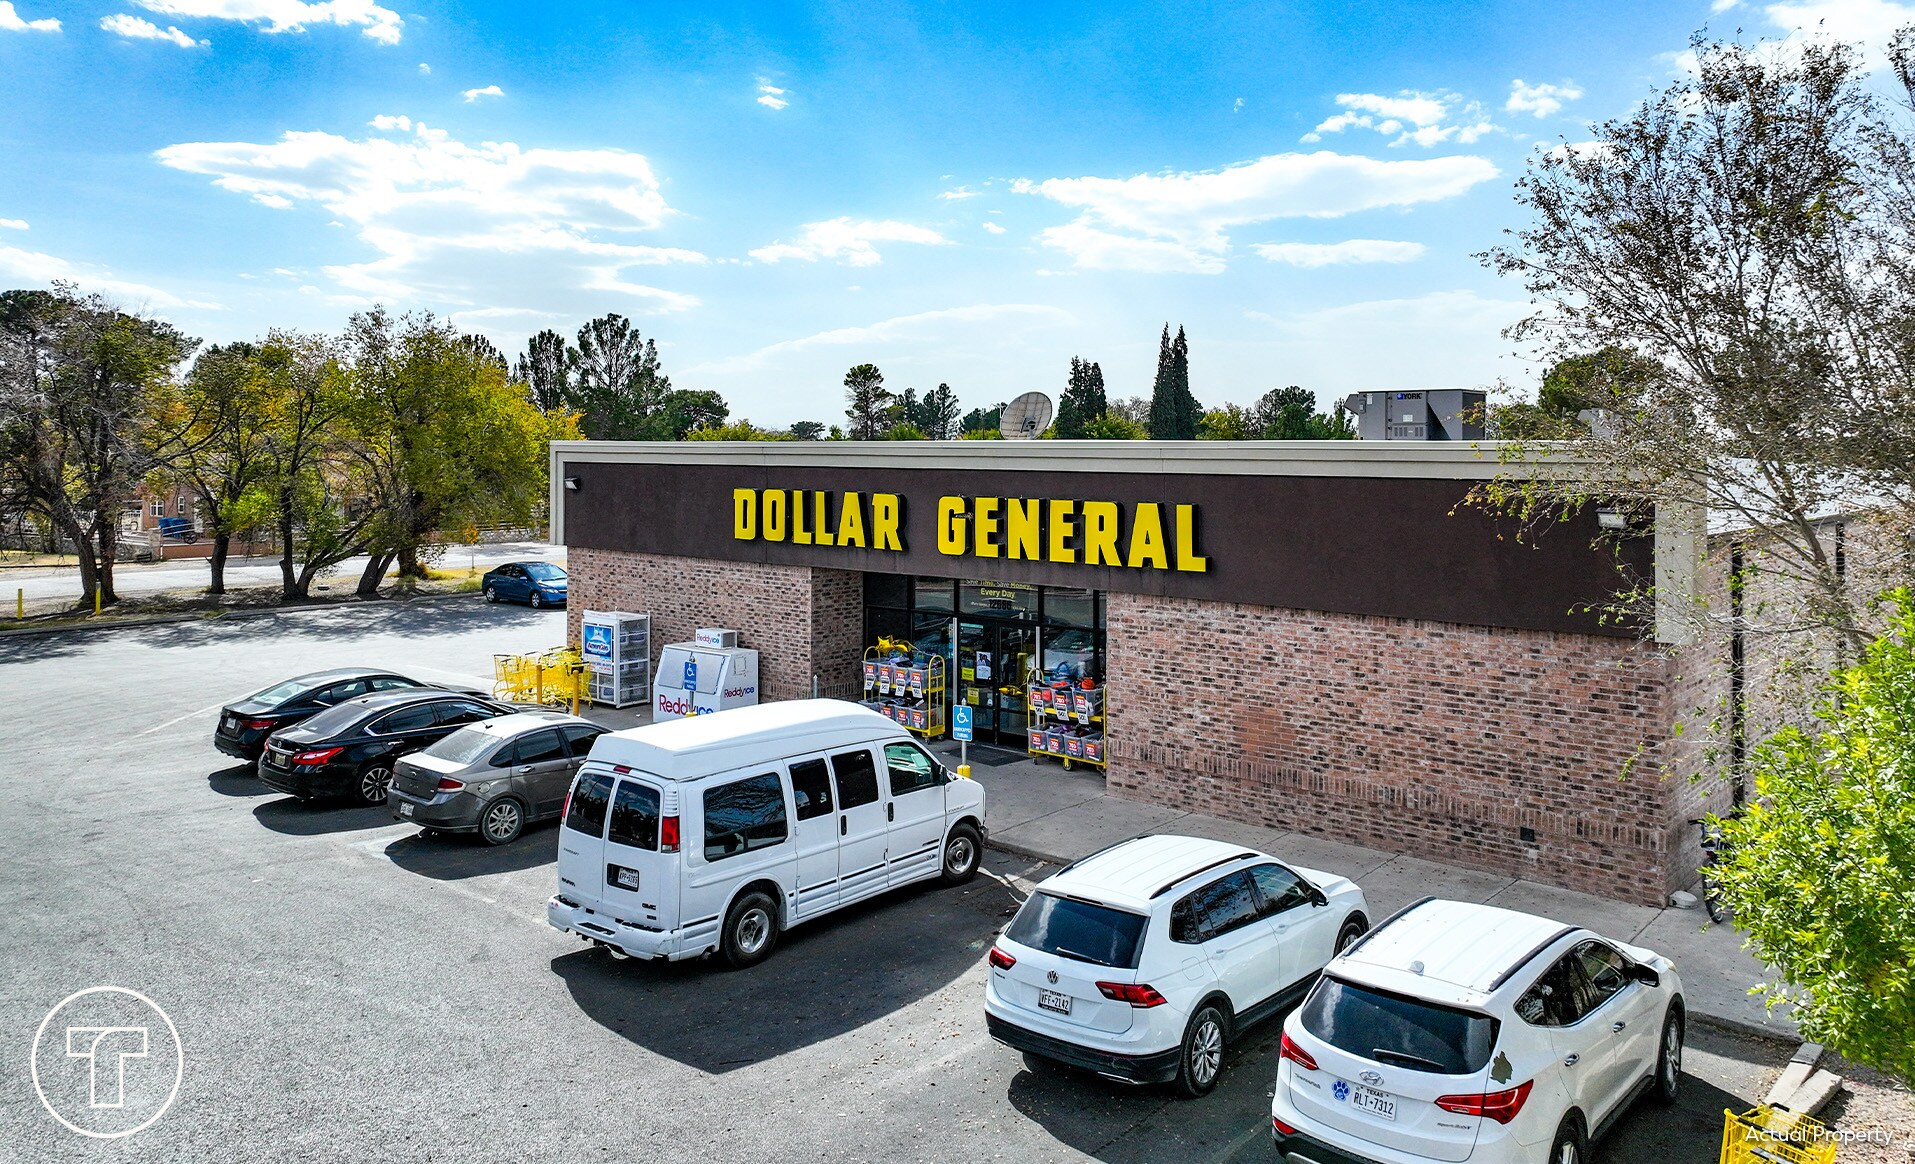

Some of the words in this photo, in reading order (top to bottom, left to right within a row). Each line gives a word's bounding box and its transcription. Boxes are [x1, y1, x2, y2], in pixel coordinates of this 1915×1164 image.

[734, 488, 903, 551] DOLLAR
[937, 496, 1207, 572] GENERAL
[980, 588, 1000, 598] Every
[1001, 589, 1016, 599] Day
[1366, 1088, 1384, 1098] TEXAS
